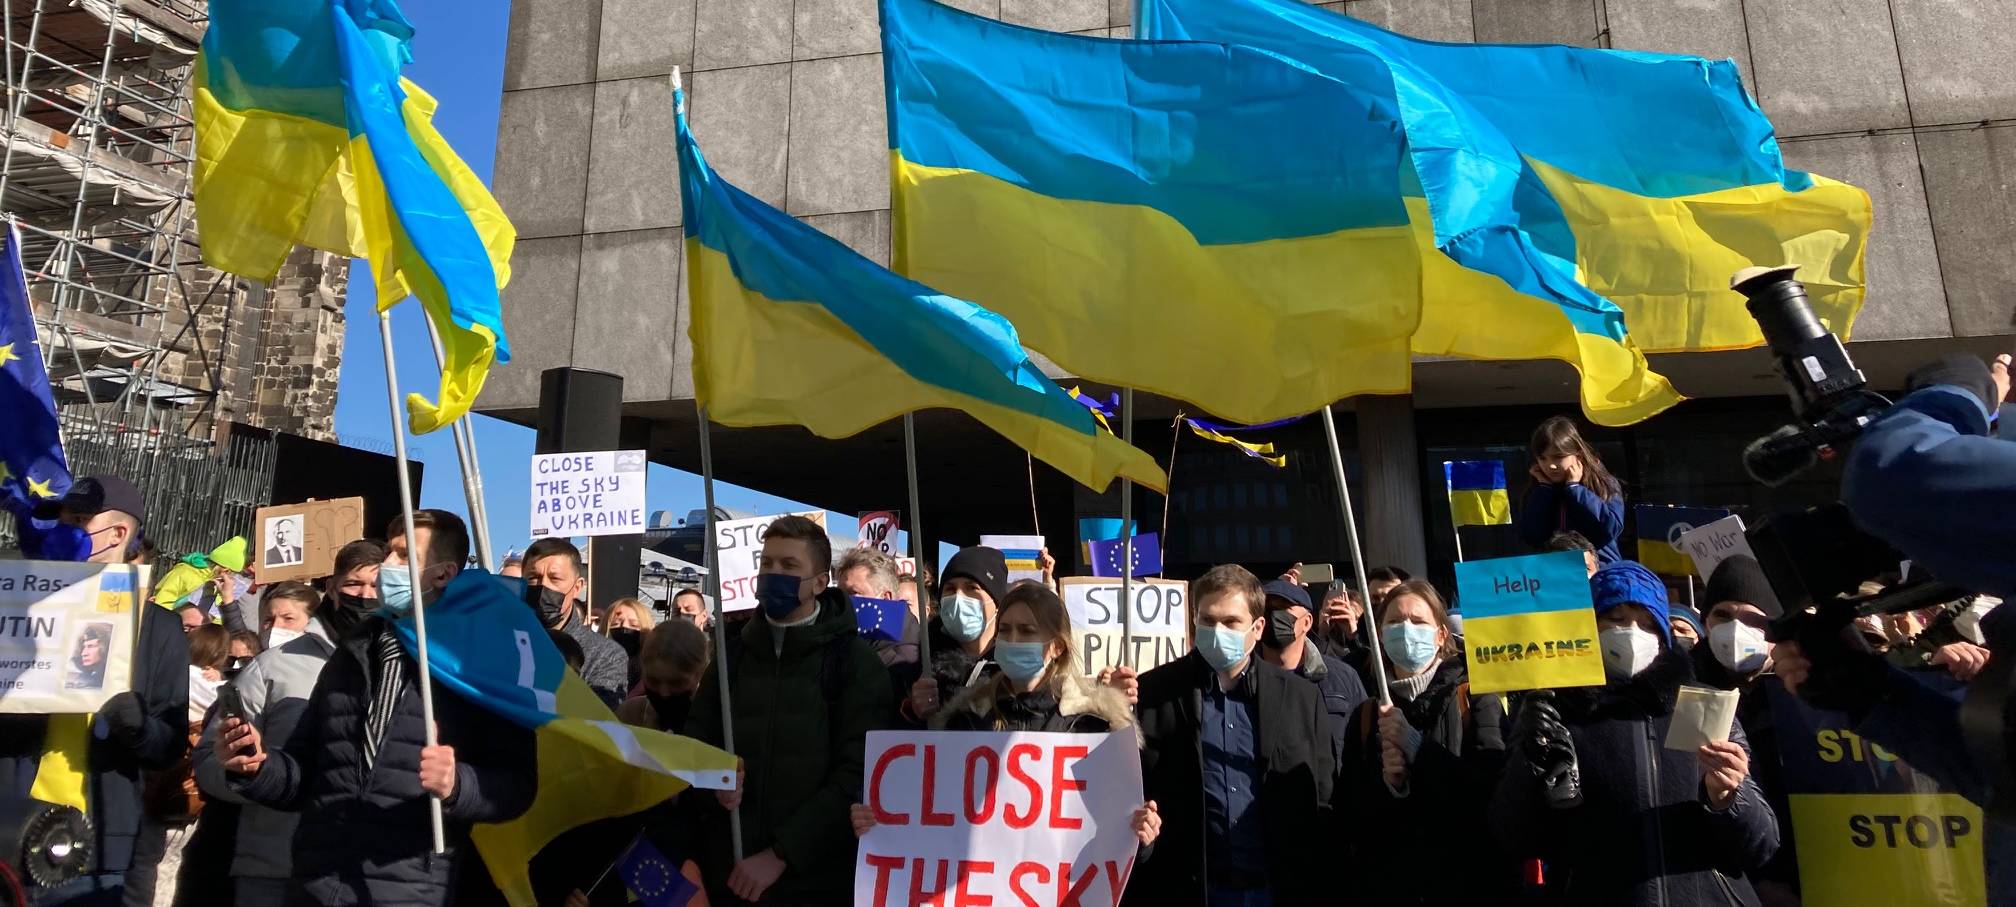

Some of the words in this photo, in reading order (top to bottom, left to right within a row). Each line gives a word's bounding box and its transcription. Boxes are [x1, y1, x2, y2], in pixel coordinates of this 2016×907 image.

[539, 456, 594, 474] CLOSE
[536, 480, 570, 496] THE
[578, 475, 619, 493] SKY
[537, 494, 603, 514] ABOVE
[552, 509, 642, 530] UKRAINE
[867, 522, 888, 541] NO
[717, 523, 769, 550] STO
[23, 574, 70, 592] Ras-
[721, 575, 757, 601] ST
[1493, 574, 1541, 597] Help
[1085, 585, 1183, 625] STOP
[1083, 633, 1185, 675] PUTIN
[1475, 639, 1593, 664] UKRAINE
[0, 679, 24, 690] ine
[1816, 729, 1899, 763] ST
[869, 743, 1089, 830] CLOSE
[1849, 815, 1971, 849] STOP
[865, 853, 995, 907] THE
[1009, 856, 1135, 907] SKY
